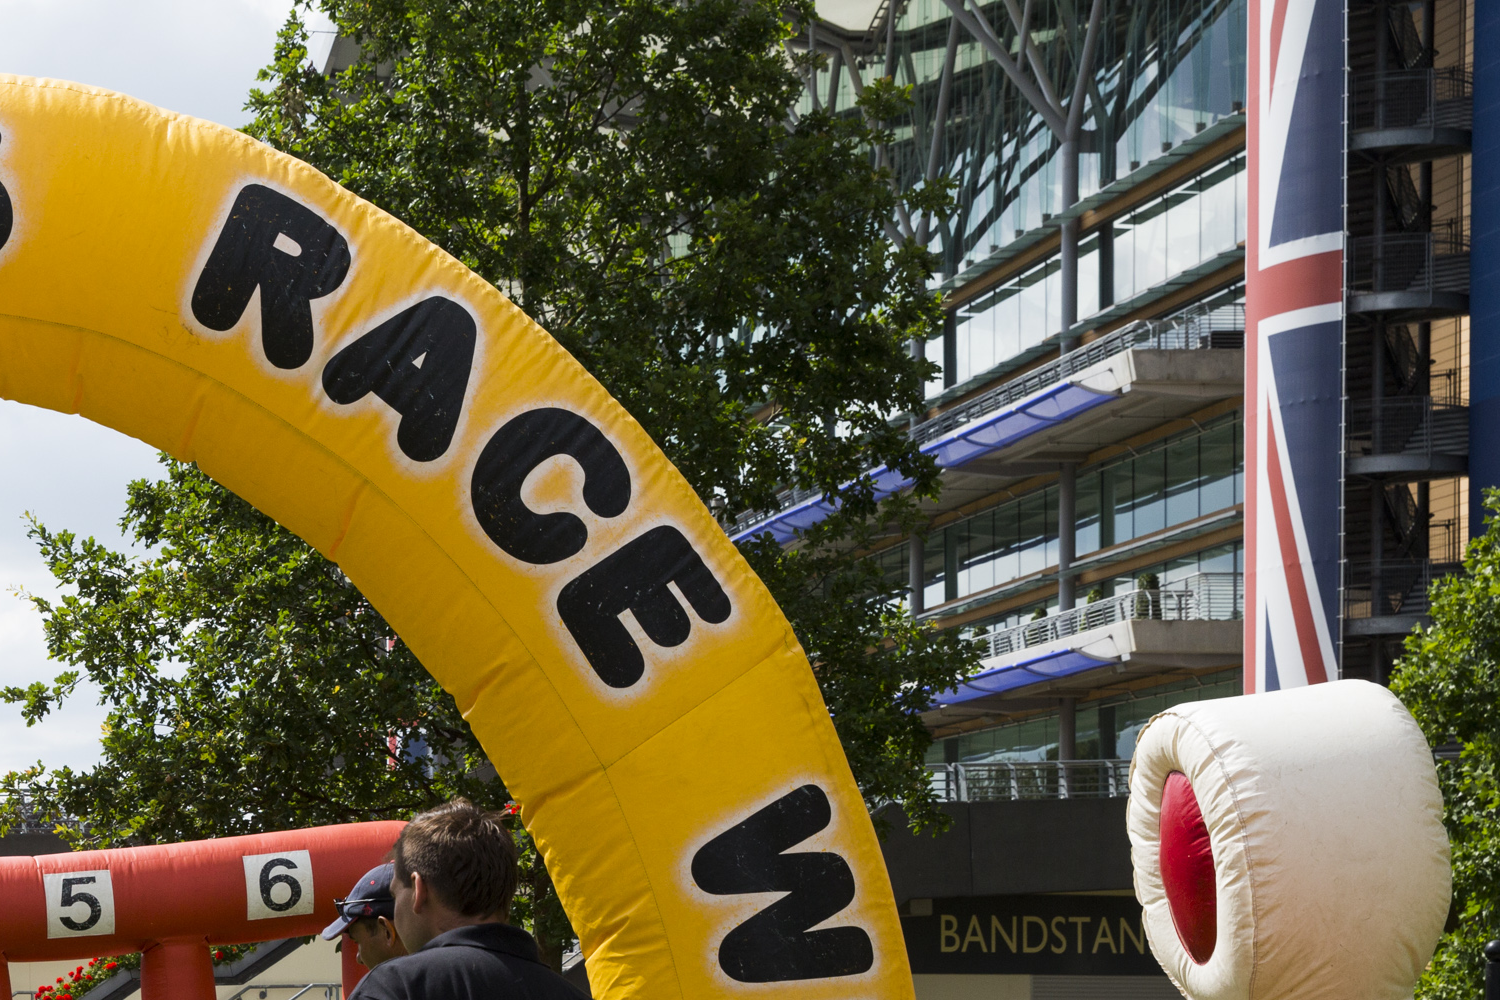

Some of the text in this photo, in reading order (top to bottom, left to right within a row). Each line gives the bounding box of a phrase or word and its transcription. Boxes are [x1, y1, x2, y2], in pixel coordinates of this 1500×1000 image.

[191, 184, 731, 688] RACE
[60, 877, 101, 931] 5
[260, 859, 301, 912] 6
[940, 914, 1152, 954] BANDSTAN
